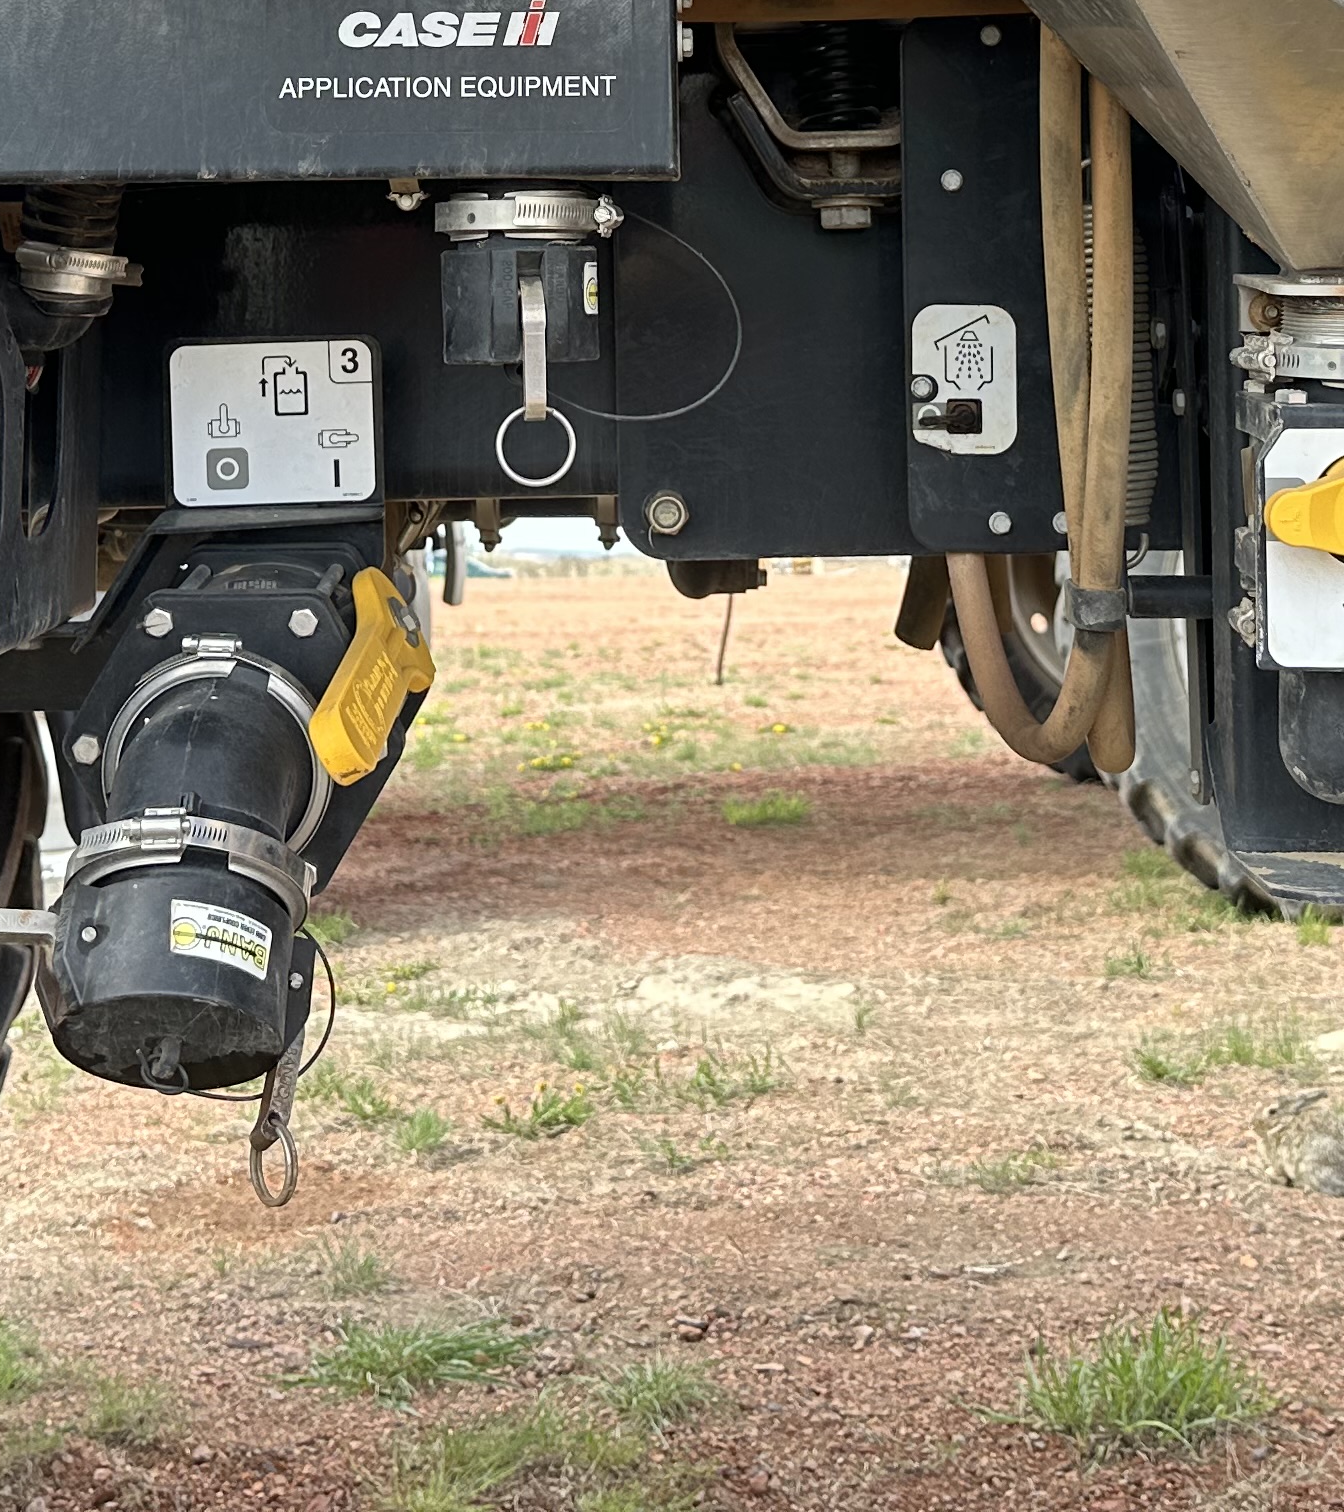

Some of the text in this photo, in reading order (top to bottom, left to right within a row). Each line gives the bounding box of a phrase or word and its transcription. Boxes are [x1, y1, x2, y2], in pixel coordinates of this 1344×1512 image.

[338, 11, 500, 48] CASE
[278, 76, 616, 99] APPLICATION EQUIPMENT
[341, 347, 359, 374] 3
